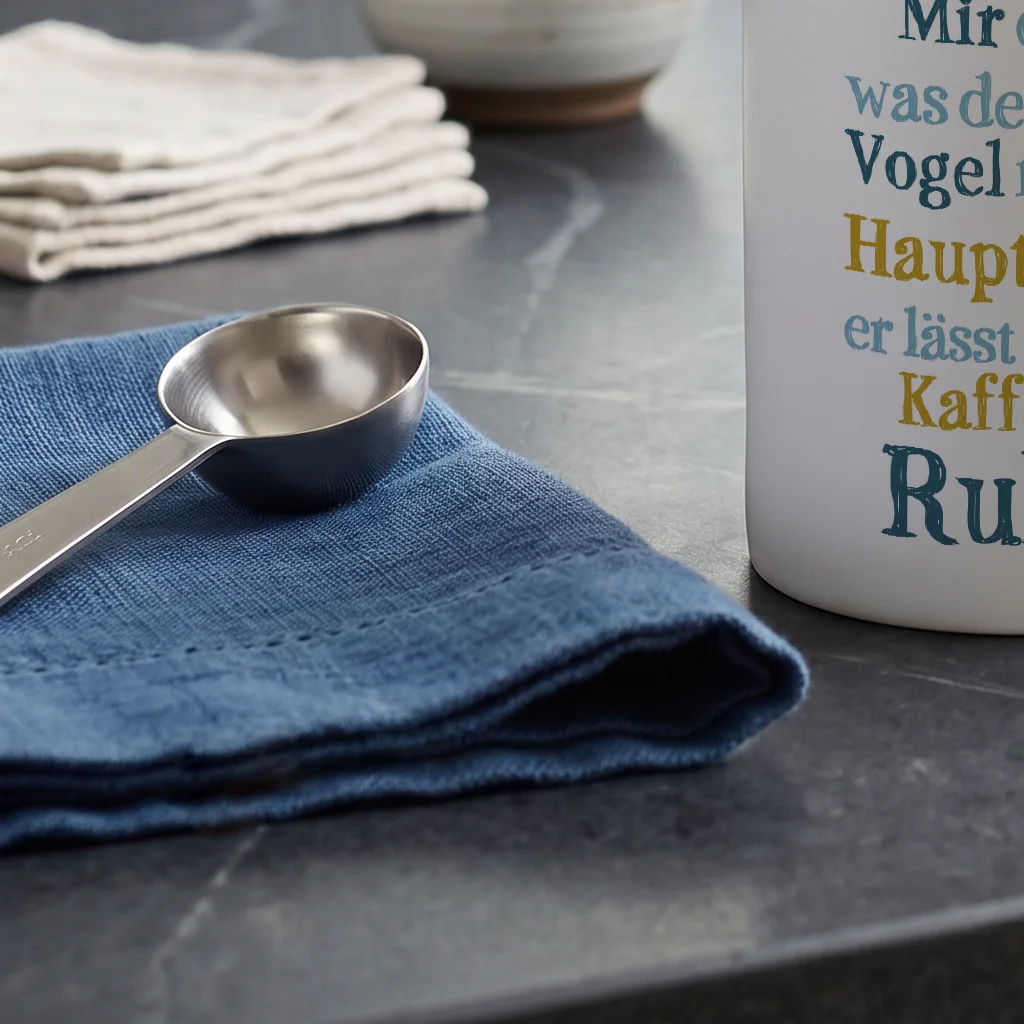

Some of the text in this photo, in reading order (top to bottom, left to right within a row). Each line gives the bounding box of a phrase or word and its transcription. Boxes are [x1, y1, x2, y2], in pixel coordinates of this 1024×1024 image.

[845, 76, 949, 126] was
[844, 128, 1006, 210] Vogel
[844, 314, 894, 355] er
[902, 306, 1016, 364] lässt
